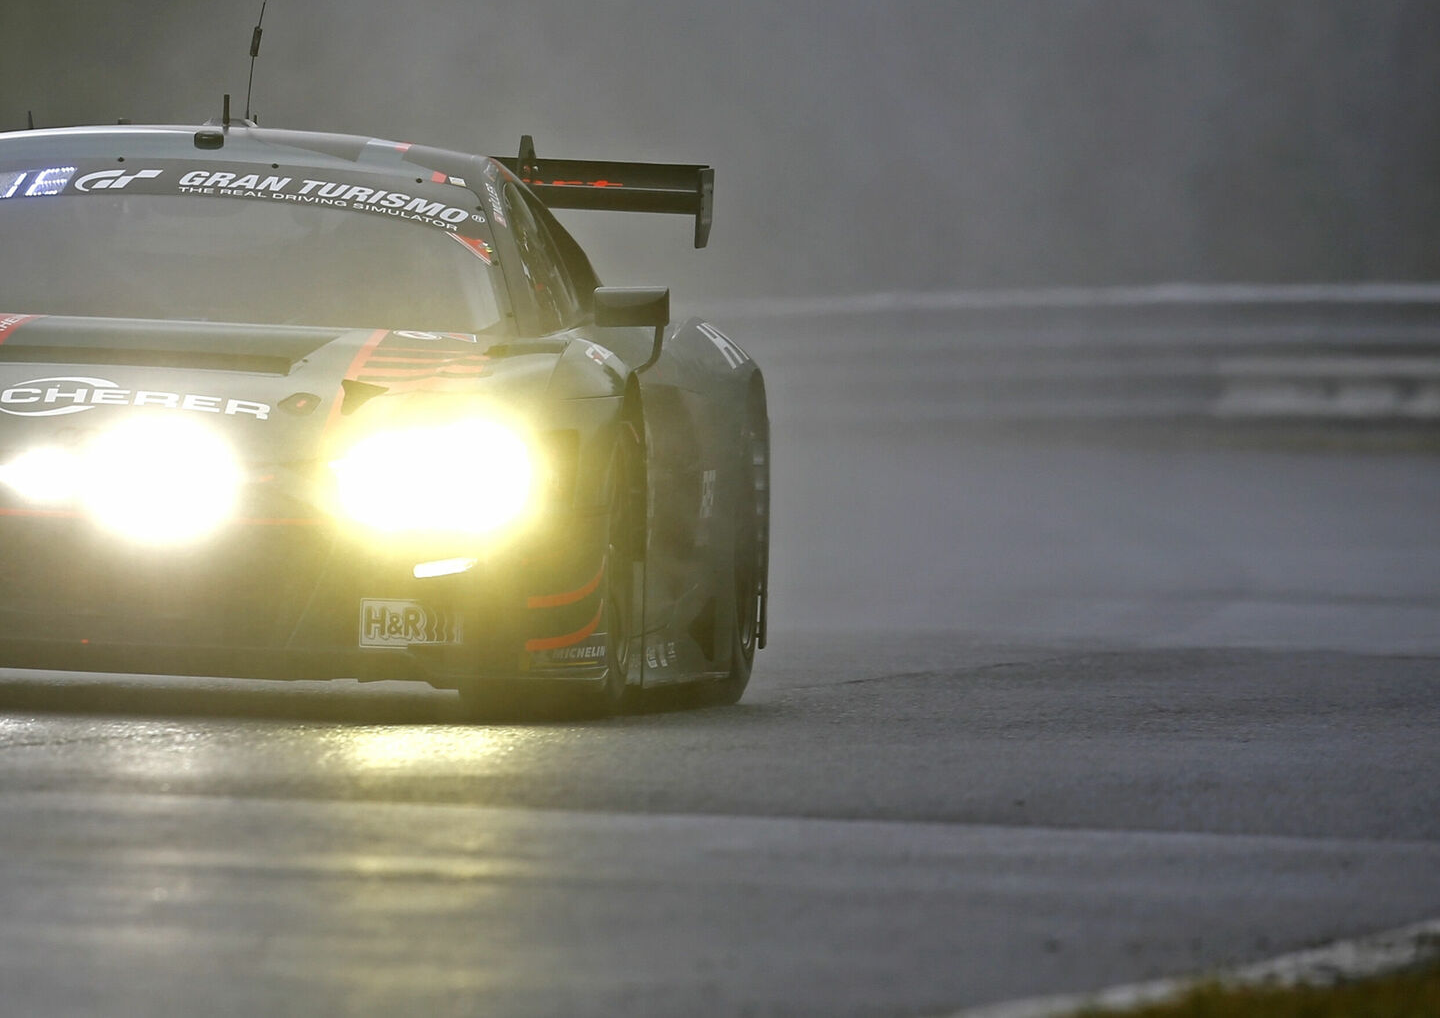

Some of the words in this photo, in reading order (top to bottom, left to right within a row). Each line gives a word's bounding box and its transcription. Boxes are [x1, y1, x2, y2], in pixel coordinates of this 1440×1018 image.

[178, 171, 292, 192] GRAN
[298, 180, 469, 224] TURISMO
[178, 186, 214, 195] THE
[219, 188, 267, 199] REAL
[272, 193, 348, 208] DRIVING
[352, 202, 458, 232] SIMULATOR
[364, 605, 427, 643] H&R
